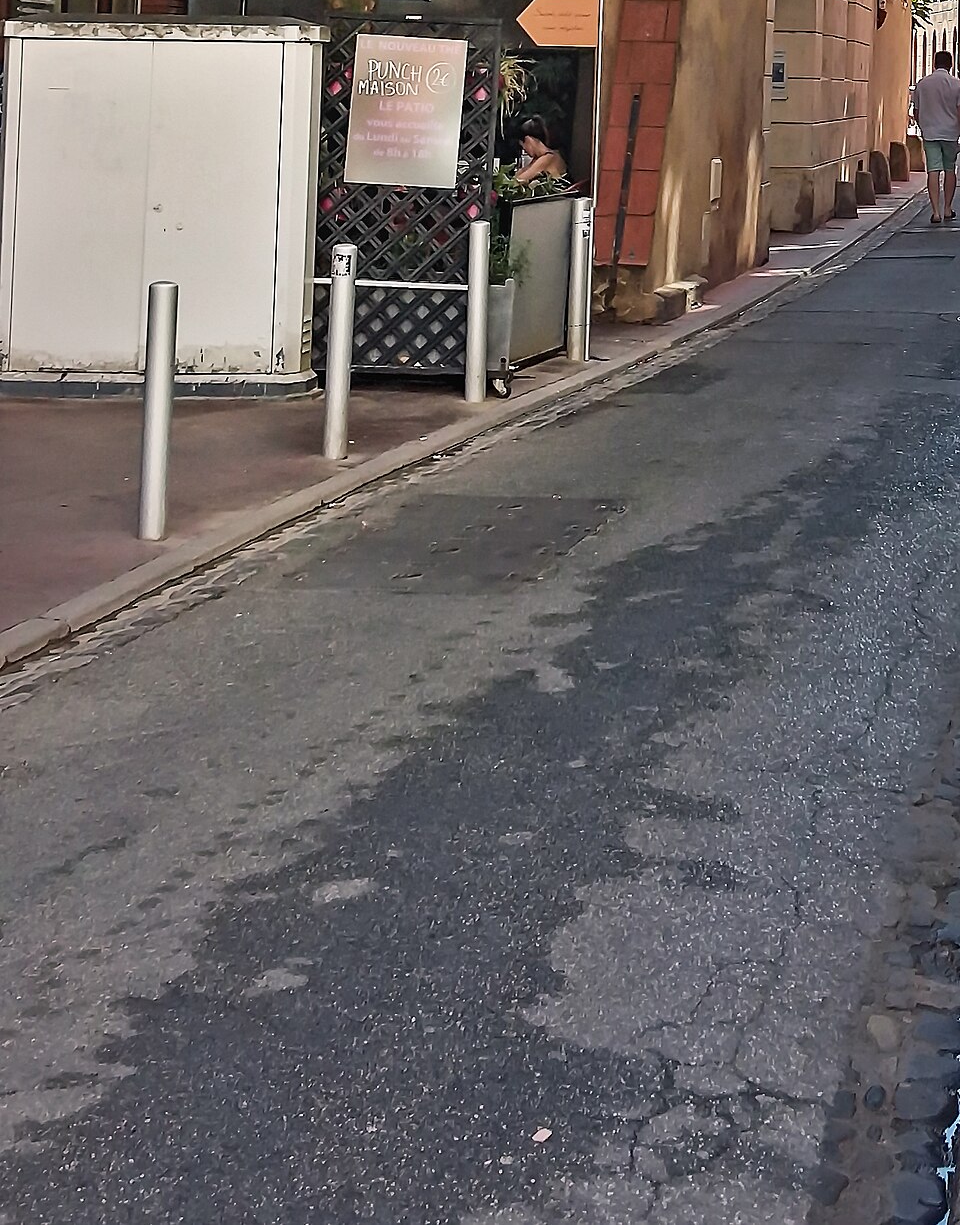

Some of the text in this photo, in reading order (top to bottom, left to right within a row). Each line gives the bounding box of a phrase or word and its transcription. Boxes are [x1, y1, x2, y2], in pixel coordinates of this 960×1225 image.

[368, 59, 423, 83] PUNCH
[358, 78, 419, 96] MAISON
[379, 100, 434, 113] LE PATIO
[367, 131, 398, 142] Lundi
